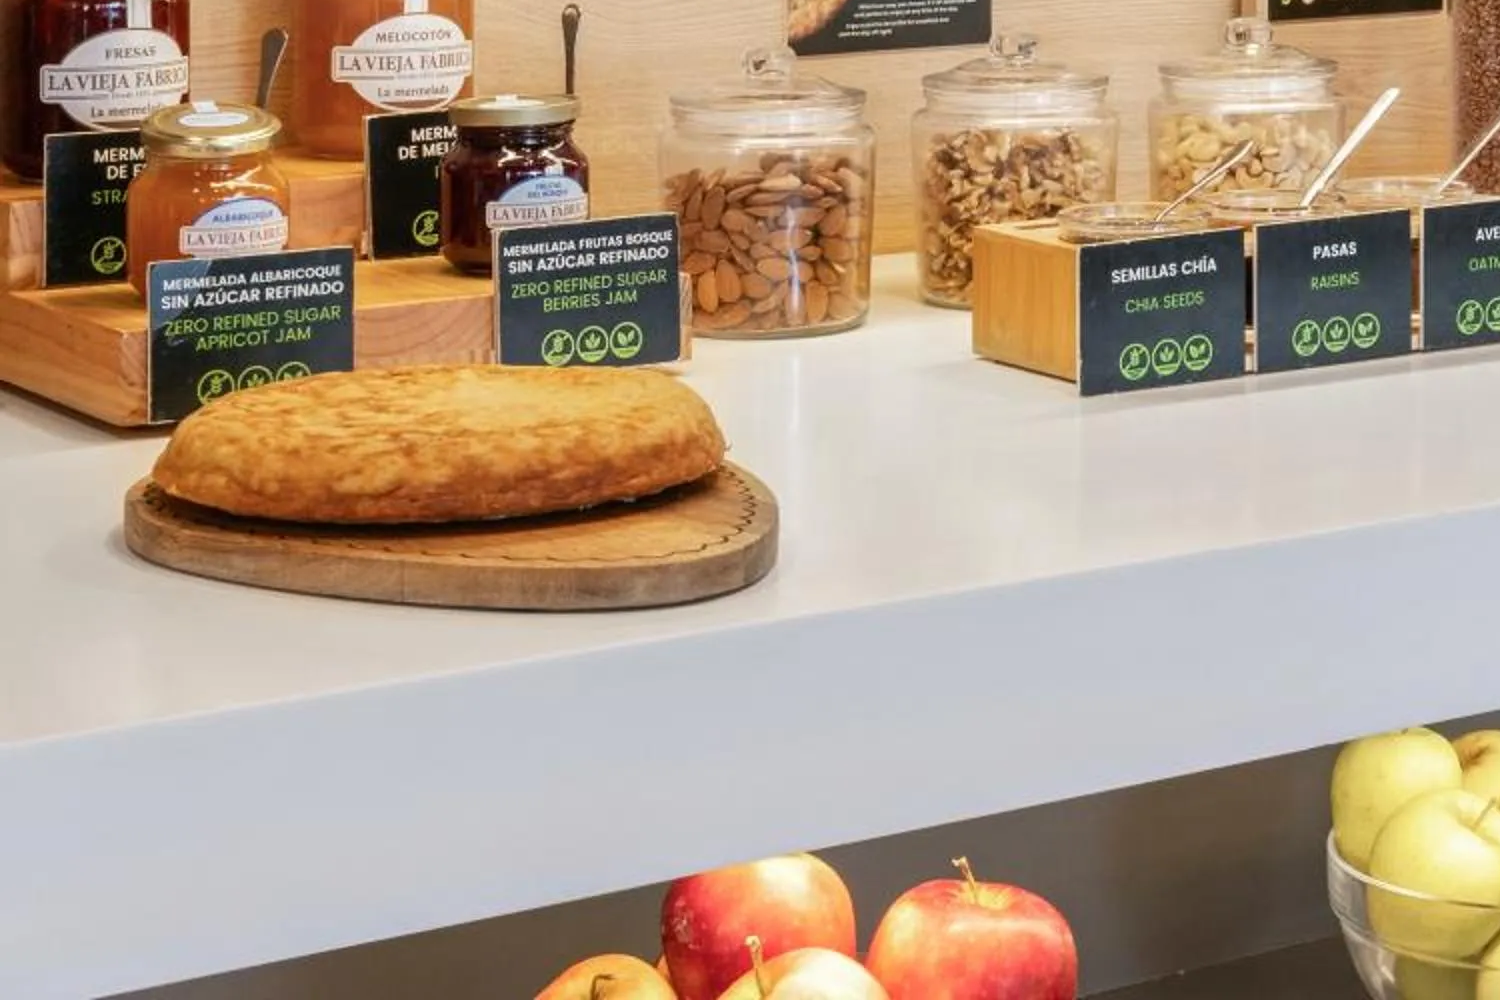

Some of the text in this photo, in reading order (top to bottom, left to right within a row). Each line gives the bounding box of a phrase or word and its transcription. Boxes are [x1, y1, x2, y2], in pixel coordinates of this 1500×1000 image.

[375, 29, 451, 43] MELOCOTÓN
[105, 46, 157, 60] FRESAS
[339, 55, 361, 71] LA
[364, 54, 414, 72] VIEJA
[49, 73, 73, 91] LA
[73, 72, 129, 93] VIEJA
[377, 88, 390, 97] La
[398, 145, 418, 160] DE
[107, 164, 128, 180] DE
[493, 208, 509, 220] LA
[513, 206, 548, 220] VIEJA
[187, 232, 205, 245] LA
[503, 229, 673, 257] MERMELADA FRUTAS BOSQUE
[508, 246, 670, 275] SIN AZÚCAR REFINADO
[1312, 241, 1358, 260] PASAS
[163, 264, 342, 291] MERMELADA ALBARICOQUE
[1111, 255, 1217, 284] SEMILLAS CHÍA
[511, 269, 668, 299] ZERO REFINED SUGAR
[1311, 271, 1360, 291] RAISINS
[161, 281, 345, 310] SIN AZÚCAR REFINADO
[543, 289, 638, 313] BERRIES JAM
[1125, 291, 1205, 313] CHIA SEEDS
[164, 305, 341, 337] ZERO REFINED SUGAR
[196, 326, 311, 351] APRICOT JAM
